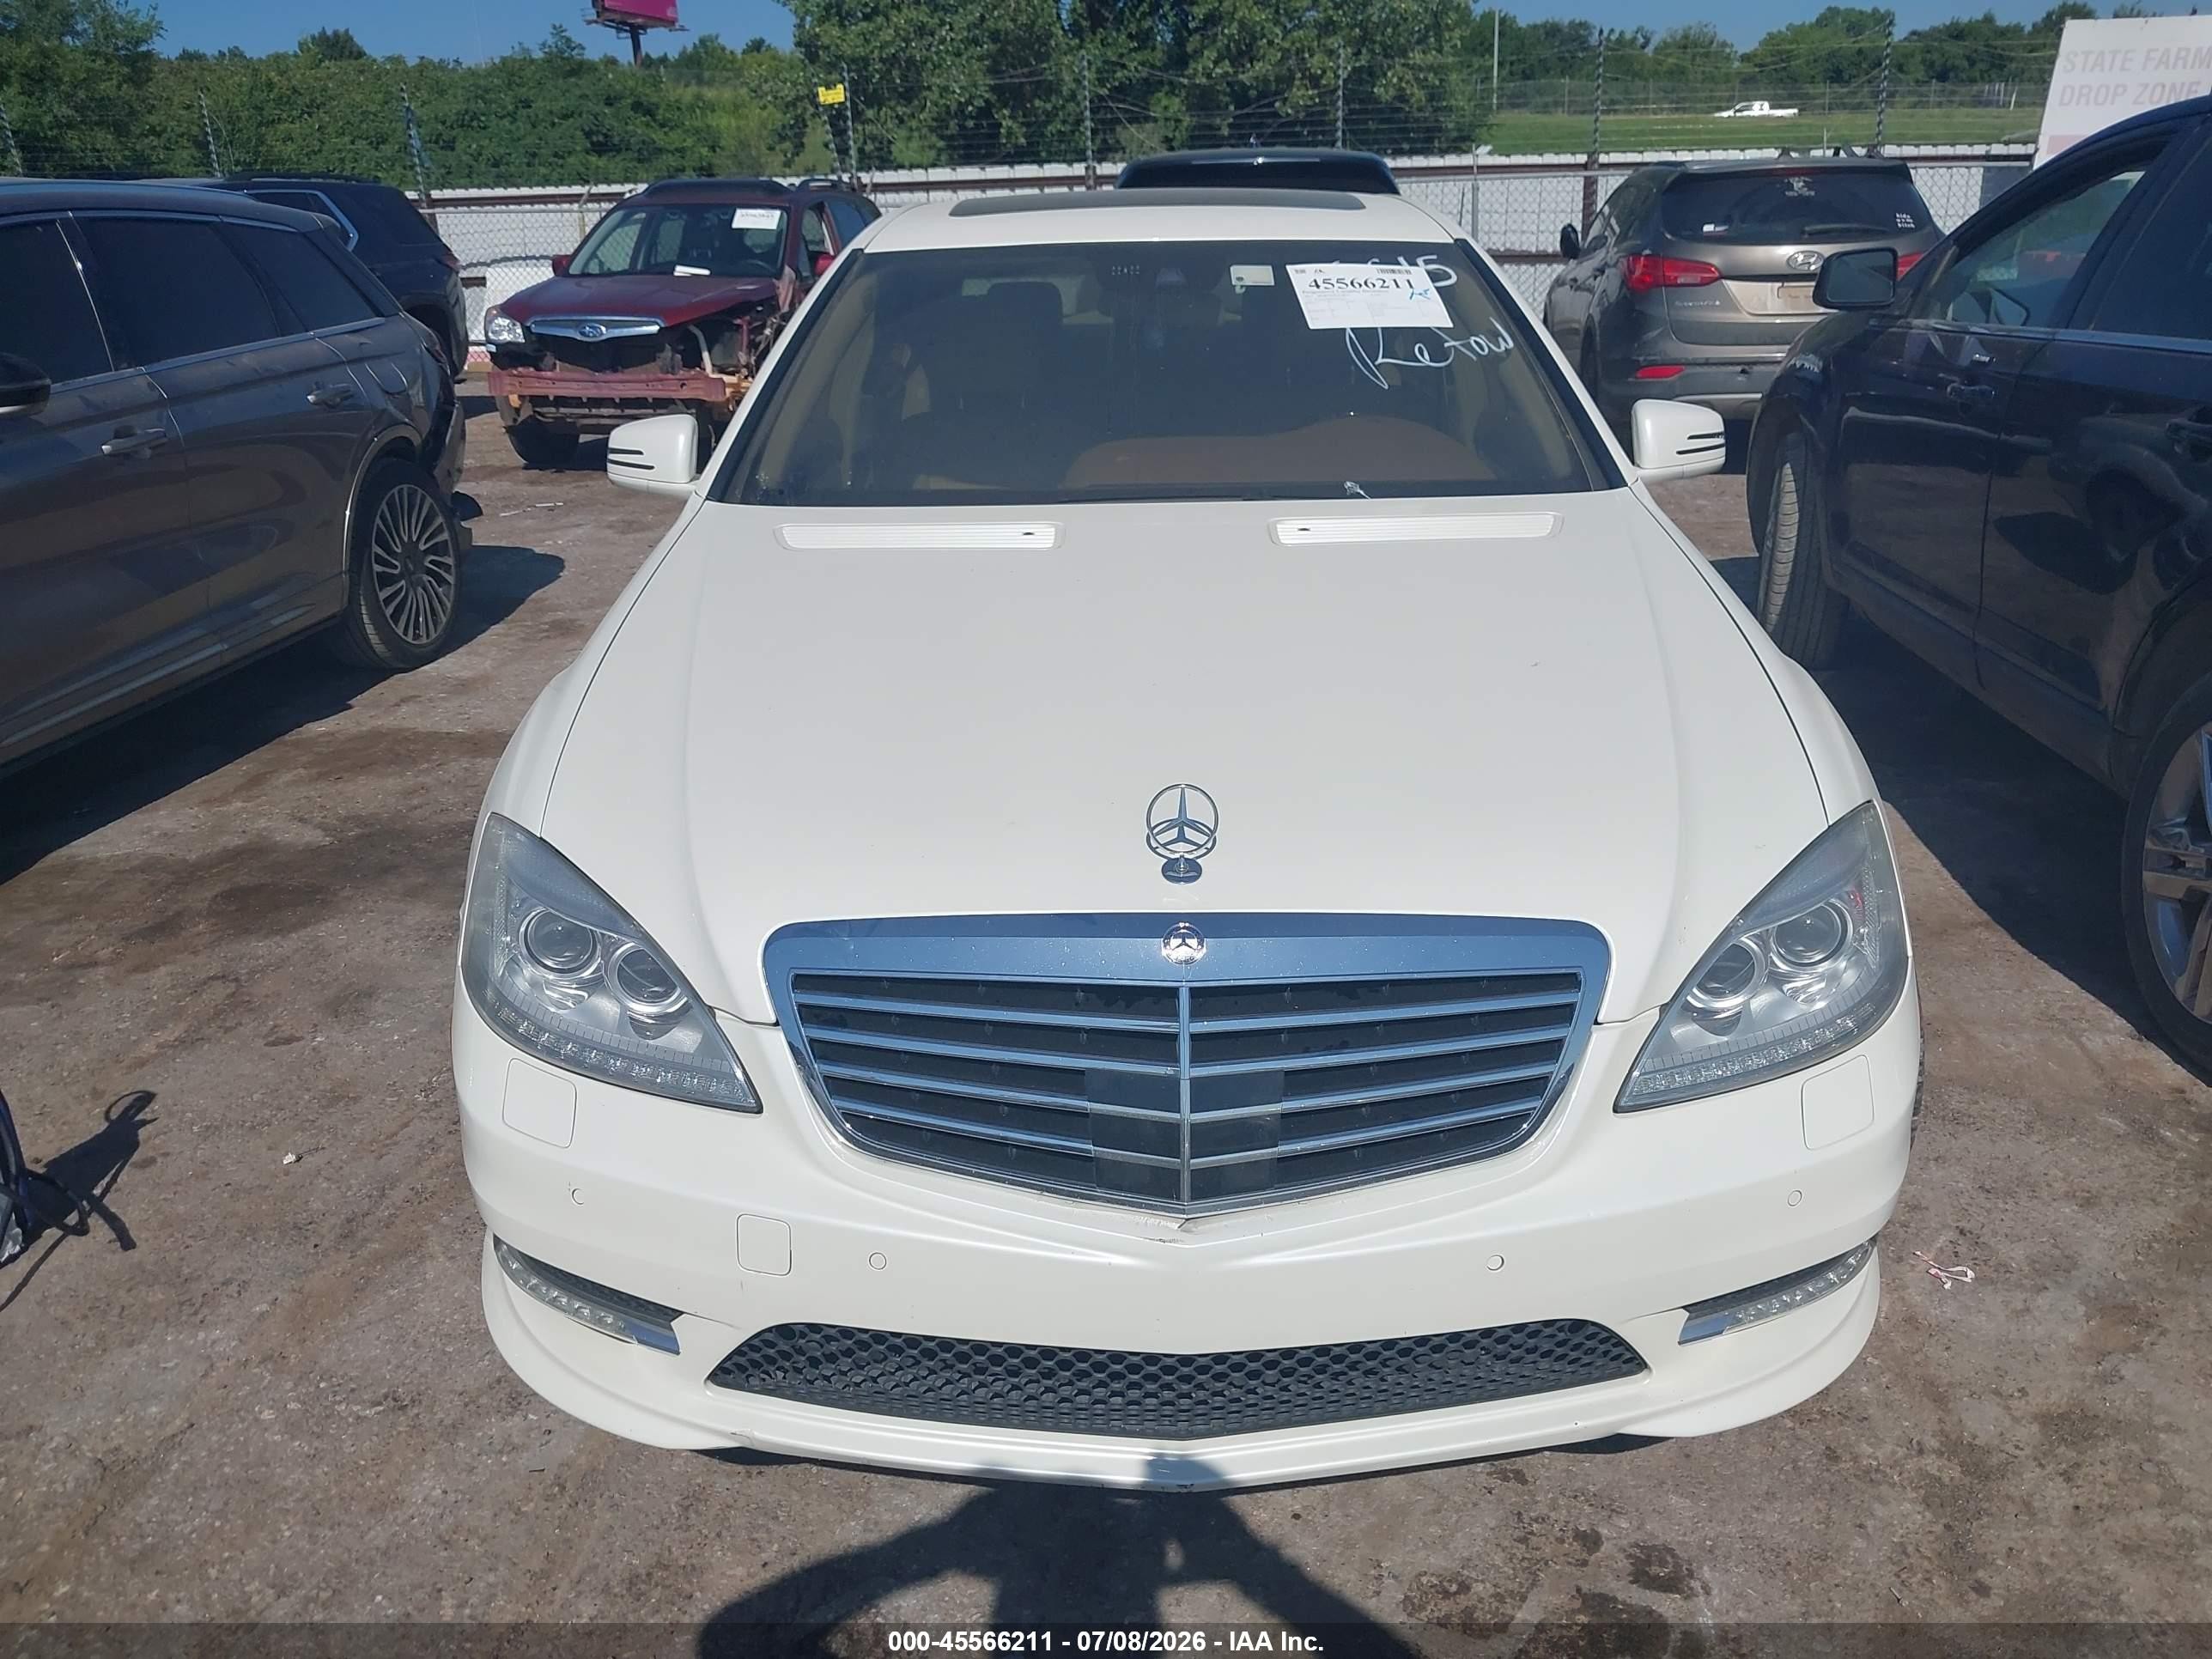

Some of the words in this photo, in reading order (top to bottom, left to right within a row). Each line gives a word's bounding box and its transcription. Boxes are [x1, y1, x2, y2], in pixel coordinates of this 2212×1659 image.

[2063, 49, 2136, 74] STATE
[2141, 46, 2212, 71] FARM
[2058, 82, 2129, 107] DROP
[2131, 81, 2203, 106] ZONE
[1308, 277, 1415, 290] 45566211
